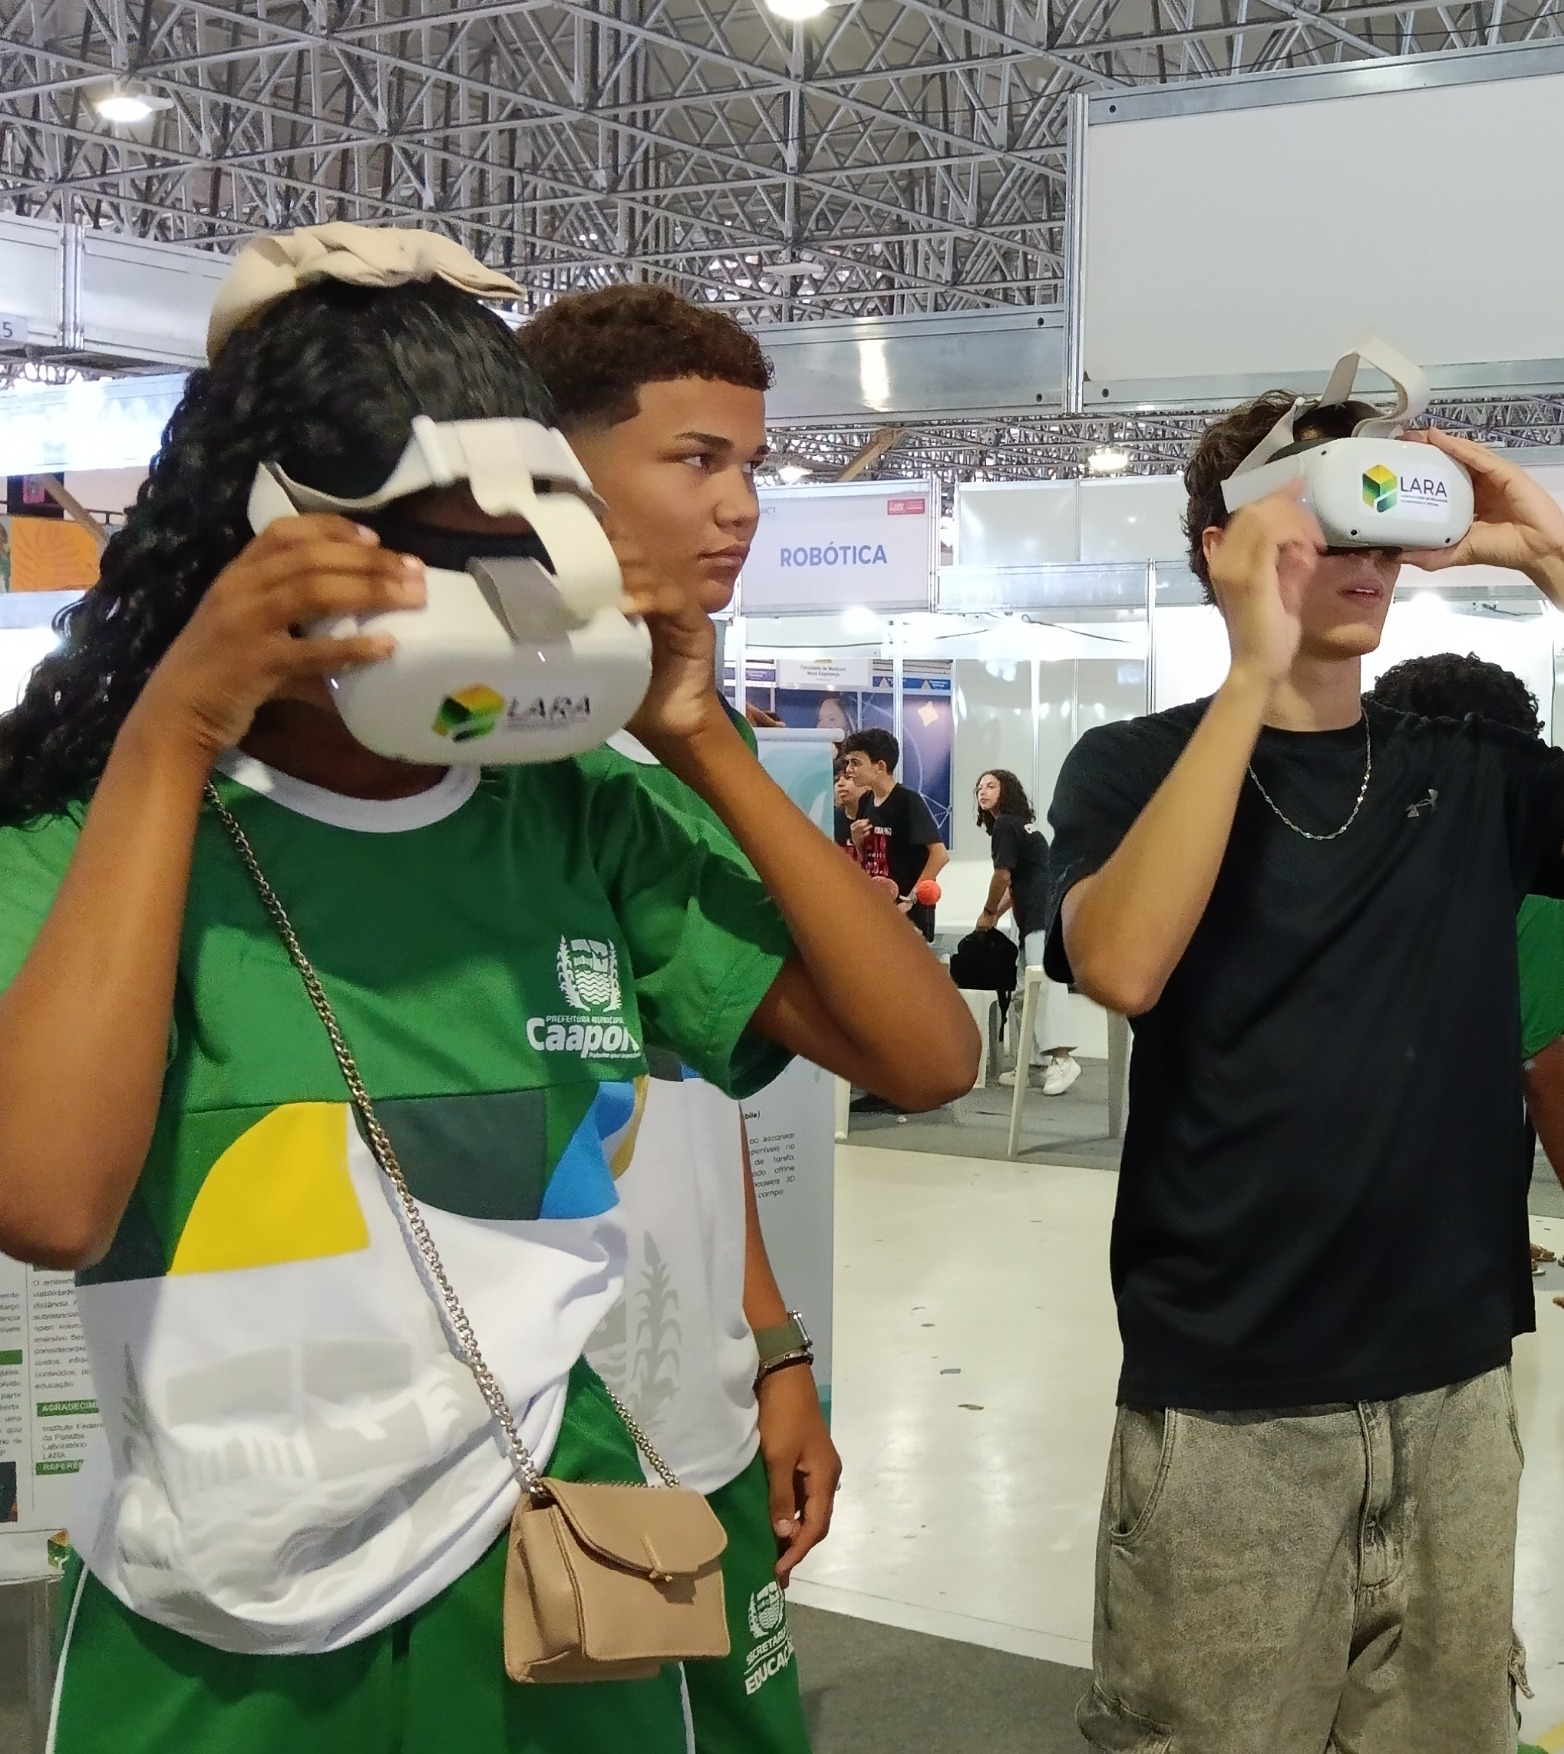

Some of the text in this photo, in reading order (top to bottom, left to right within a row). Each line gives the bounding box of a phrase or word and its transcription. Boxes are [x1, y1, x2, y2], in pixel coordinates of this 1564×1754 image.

[1400, 476, 1448, 498] LARA
[760, 506, 777, 515] NCT
[780, 541, 888, 567] ROBÓTICA
[546, 1014, 591, 1024] PREFEITURA
[525, 1016, 641, 1059] Caapor
